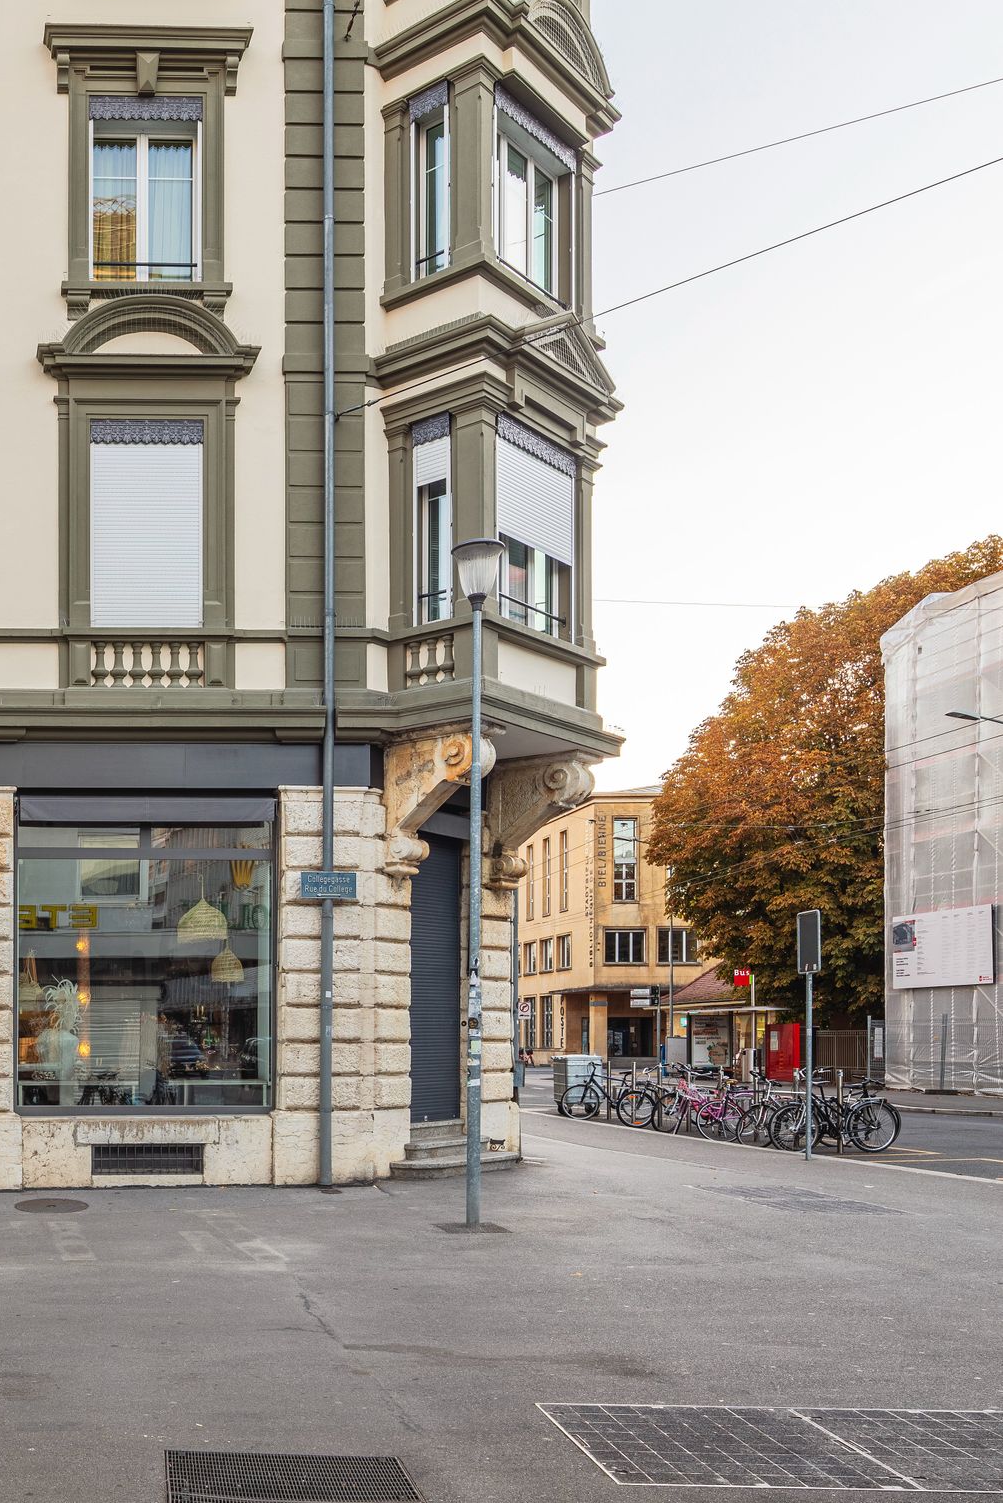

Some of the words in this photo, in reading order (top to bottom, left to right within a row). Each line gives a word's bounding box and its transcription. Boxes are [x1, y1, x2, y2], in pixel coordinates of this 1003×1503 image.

[598, 815, 606, 887] BIEL/BIENNE
[305, 885, 317, 893] Rue
[319, 885, 327, 893] du
